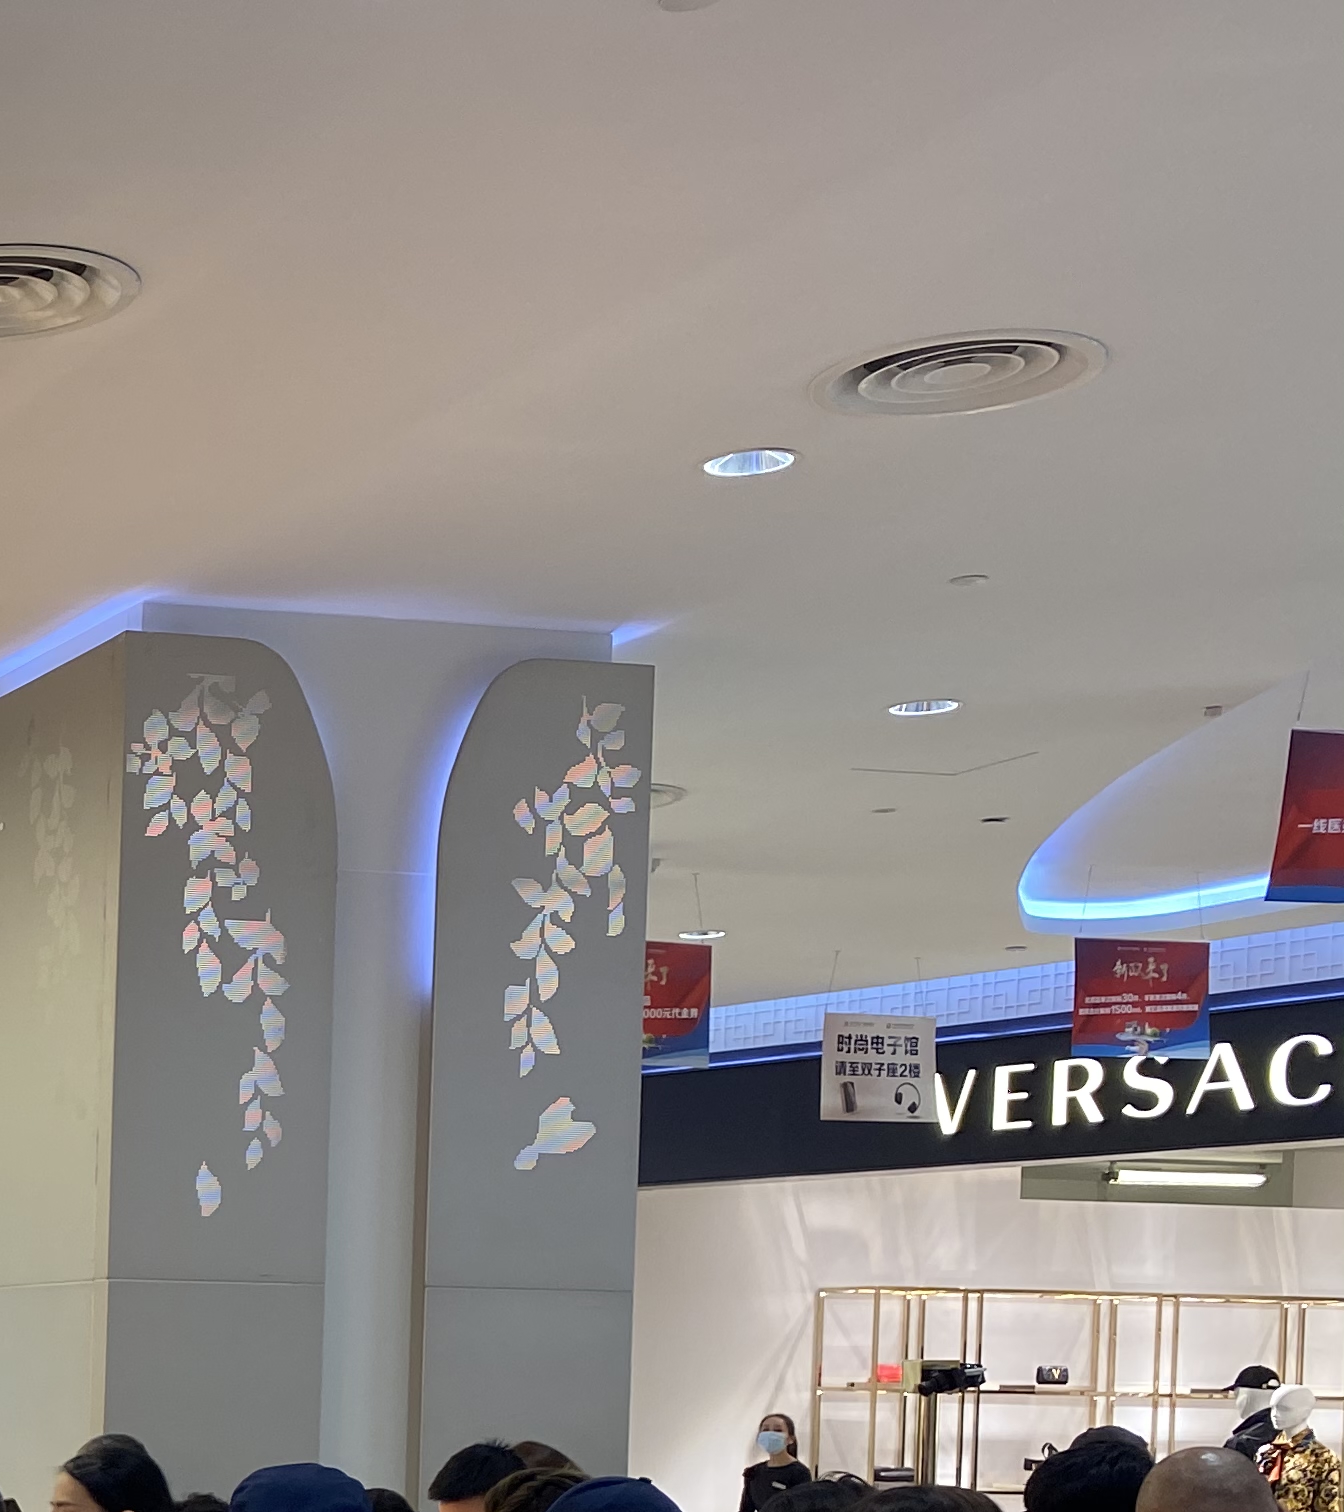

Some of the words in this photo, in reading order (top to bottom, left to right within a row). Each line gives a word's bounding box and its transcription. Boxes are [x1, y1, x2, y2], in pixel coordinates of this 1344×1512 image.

[1297, 818, 1344, 833] 一线医
[836, 1033, 920, 1056] 时尚电子馆
[835, 1060, 921, 1079] 请至双子座2楼
[934, 1034, 1333, 1136] VERSAC
